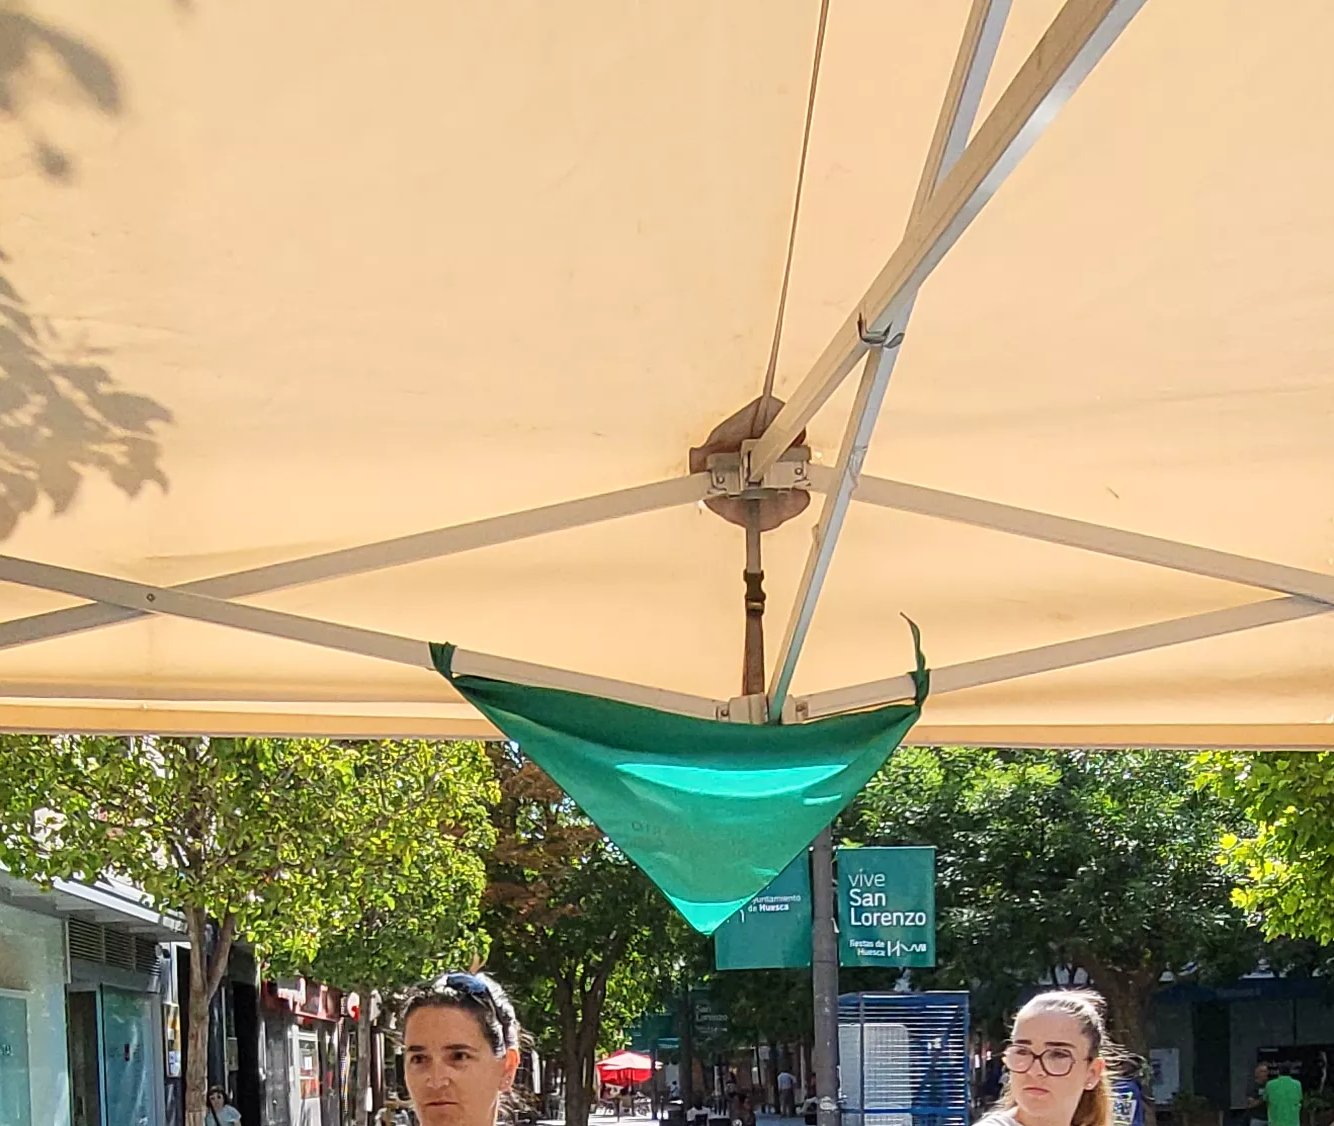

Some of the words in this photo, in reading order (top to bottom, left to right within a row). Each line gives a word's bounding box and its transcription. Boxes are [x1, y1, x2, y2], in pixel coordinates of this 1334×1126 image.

[848, 868, 885, 888] vive
[752, 894, 801, 905] yuntamiento
[849, 888, 886, 907] San
[747, 904, 757, 913] de
[759, 902, 790, 912] Huesca
[850, 907, 927, 927] Lorenzo
[849, 939, 875, 948] Fiestas
[876, 939, 885, 948] de
[857, 948, 885, 957] Huesca
